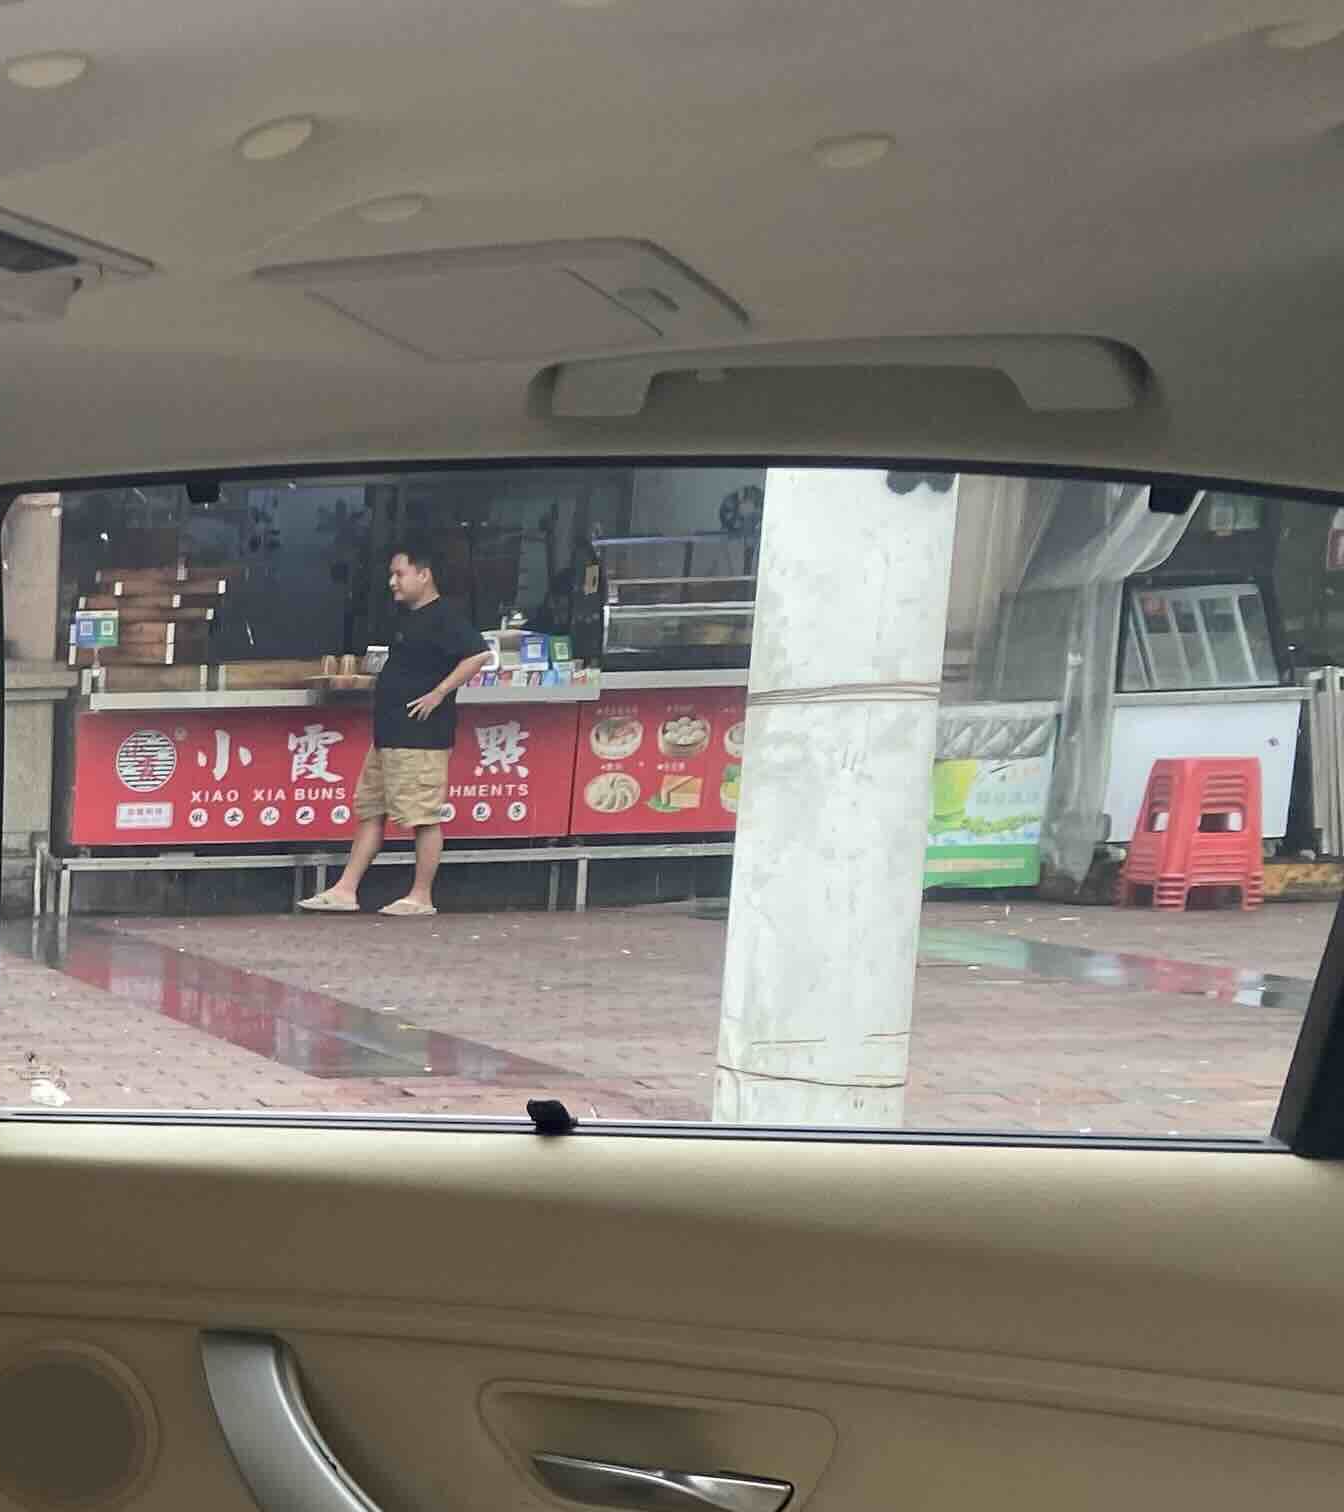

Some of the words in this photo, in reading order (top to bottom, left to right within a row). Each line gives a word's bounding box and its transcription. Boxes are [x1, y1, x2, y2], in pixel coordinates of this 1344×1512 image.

[197, 720, 530, 782] 小霞點
[190, 789, 240, 803] XIAO
[253, 788, 287, 801] XIA
[294, 786, 347, 801] BUNS
